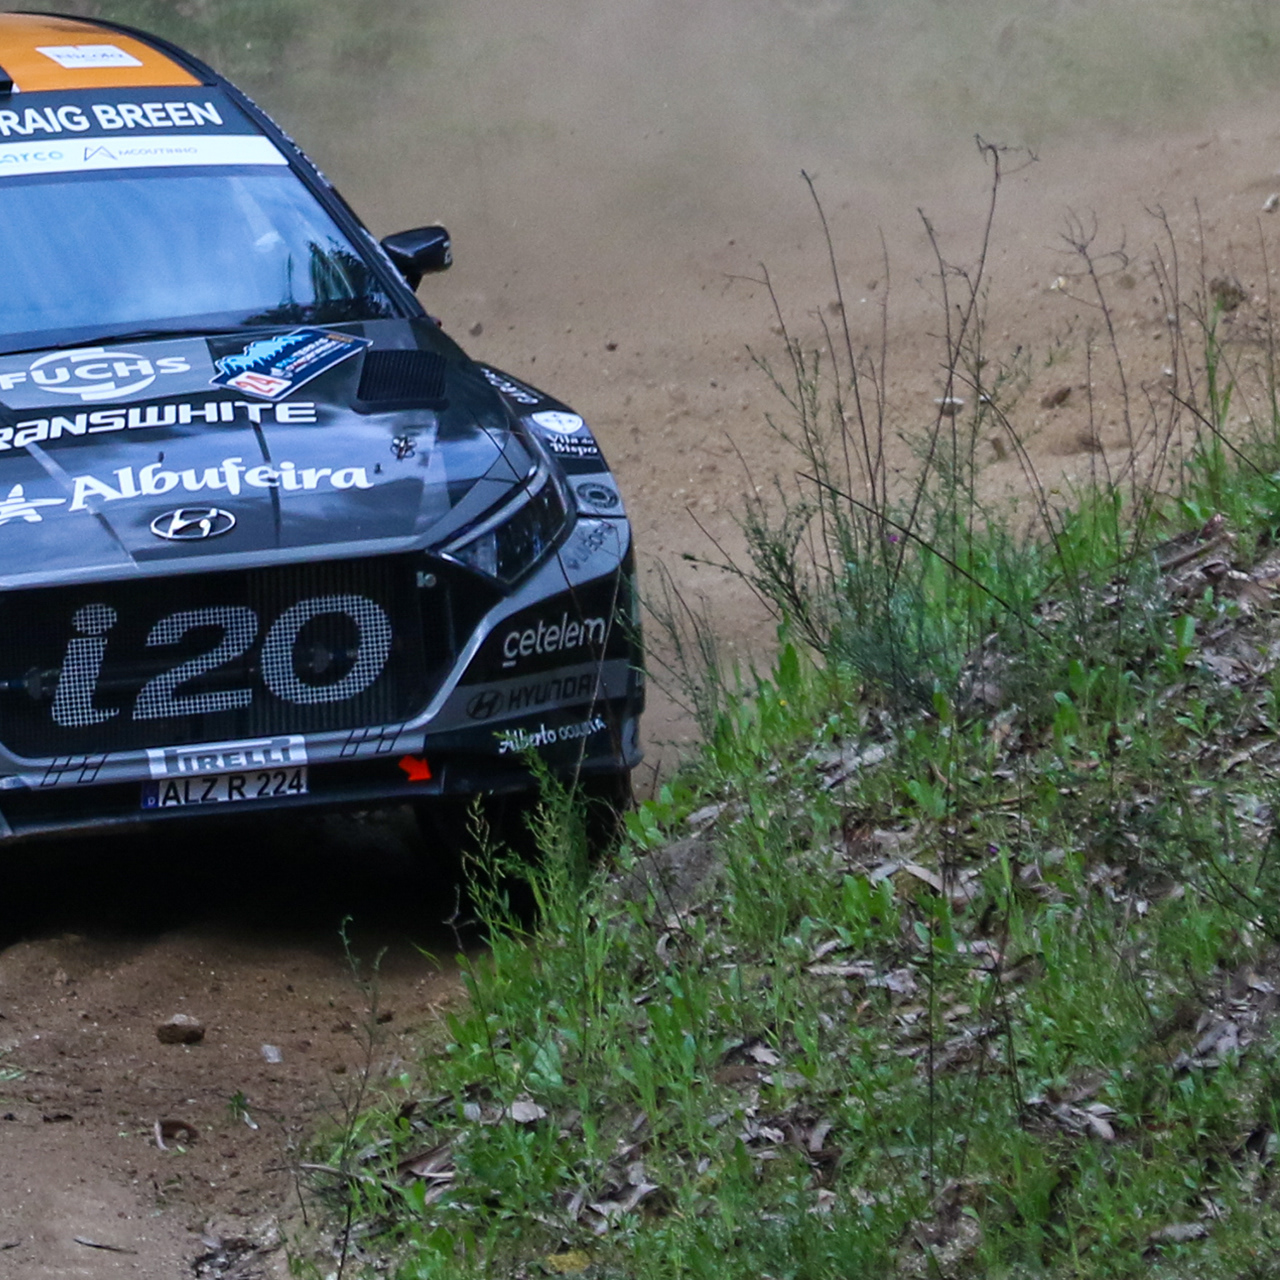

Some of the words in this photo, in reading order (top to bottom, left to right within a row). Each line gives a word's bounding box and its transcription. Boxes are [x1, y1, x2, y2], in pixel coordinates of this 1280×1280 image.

[91, 101, 224, 131] BREEN
[67, 457, 375, 513] Albufeira
[51, 594, 393, 729] i20
[503, 612, 606, 662] cetelem
[162, 777, 219, 807] ALZ
[227, 773, 247, 801] R
[256, 768, 304, 798] 224
